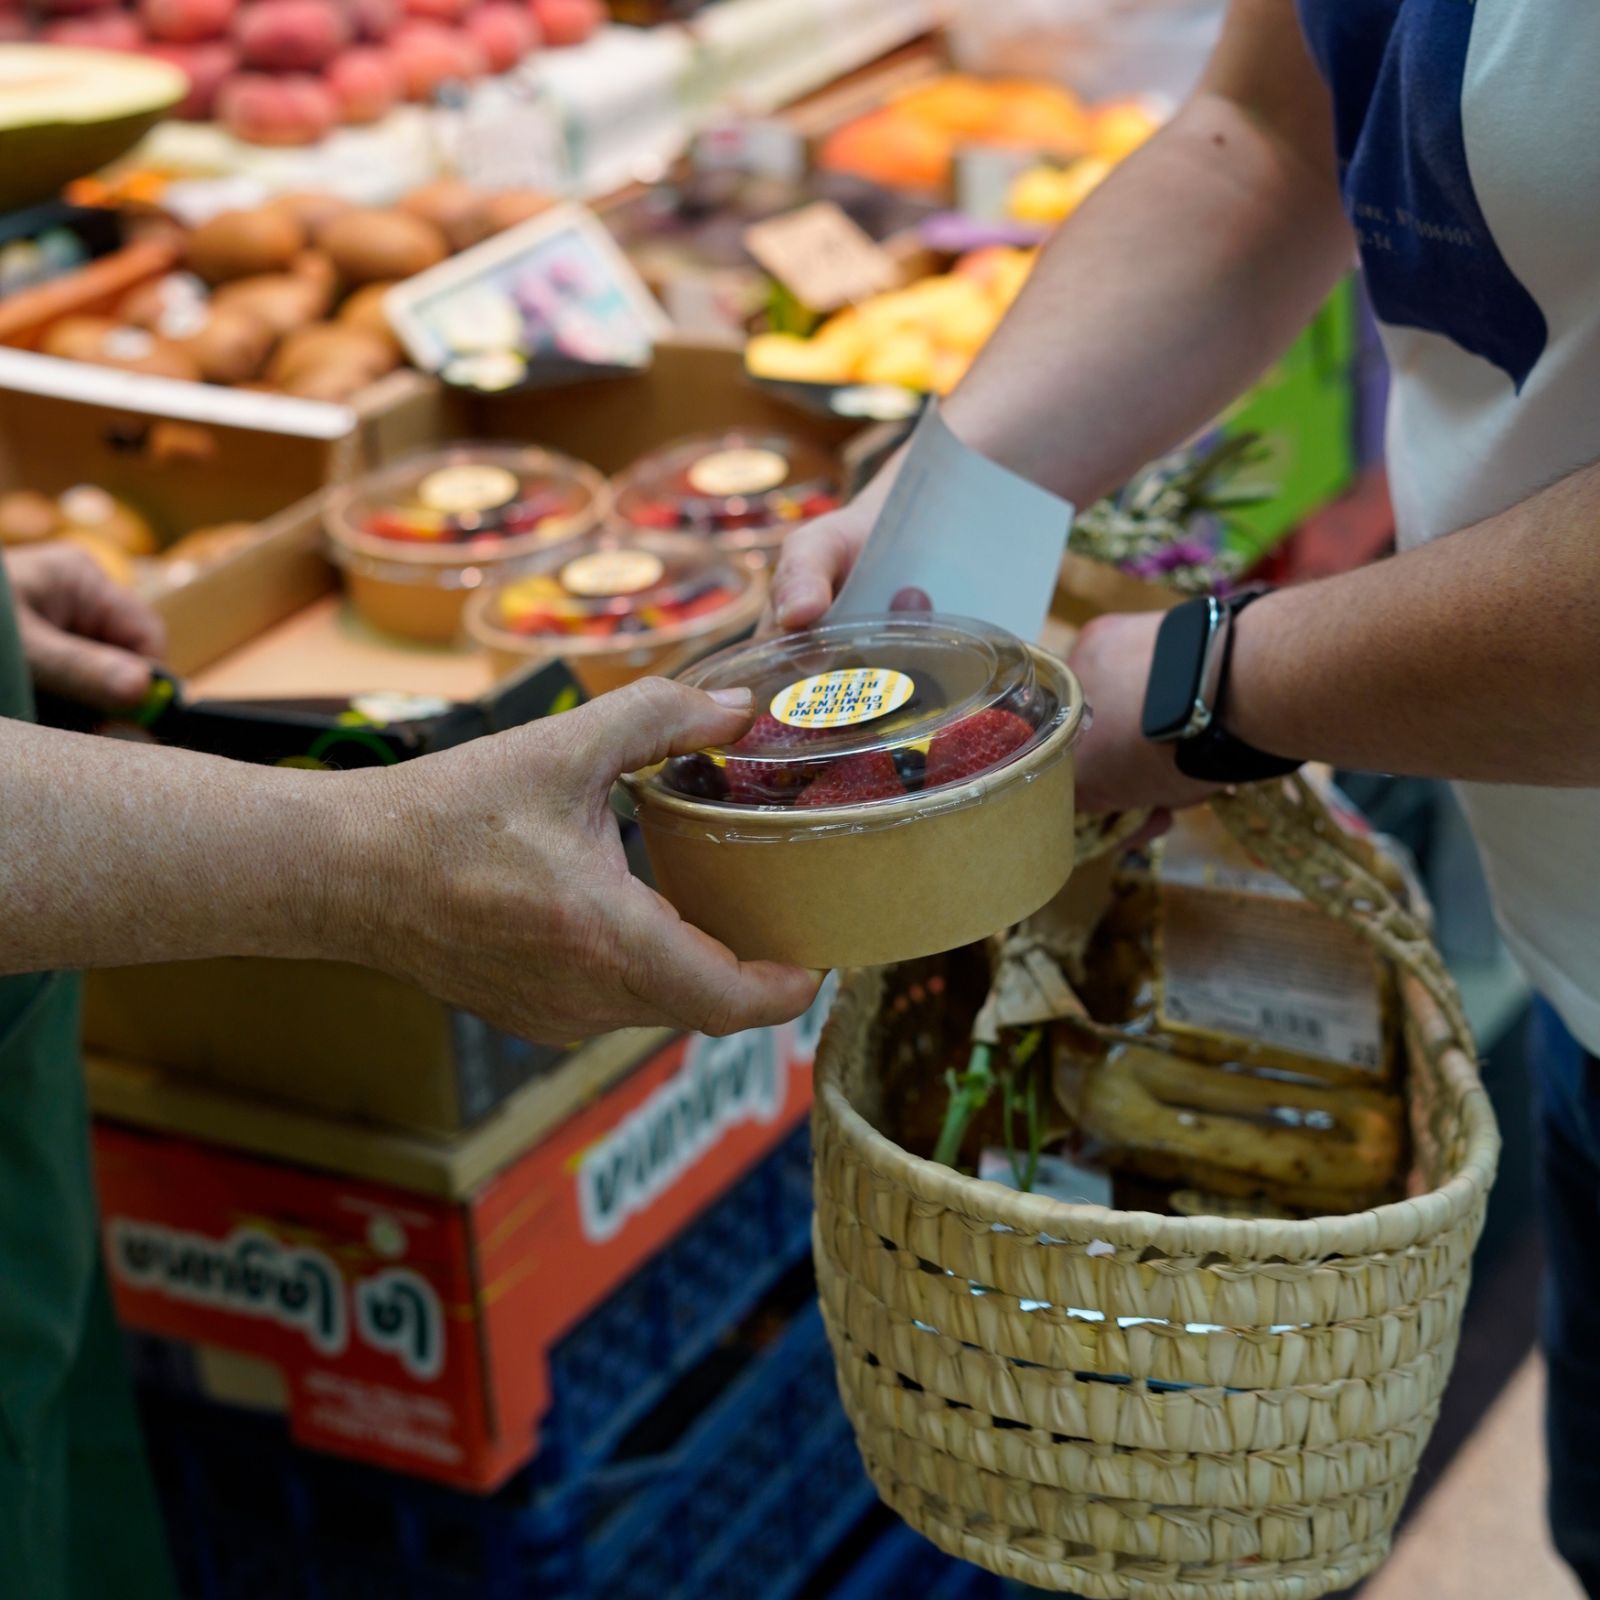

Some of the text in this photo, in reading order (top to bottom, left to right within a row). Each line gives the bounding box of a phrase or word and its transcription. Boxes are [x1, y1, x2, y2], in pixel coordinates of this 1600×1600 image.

[811, 681, 879, 694] RETIRO
[822, 690, 863, 700] EN EL
[796, 695, 883, 709] COMIENZA
[788, 702, 882, 717] EL VERANO
